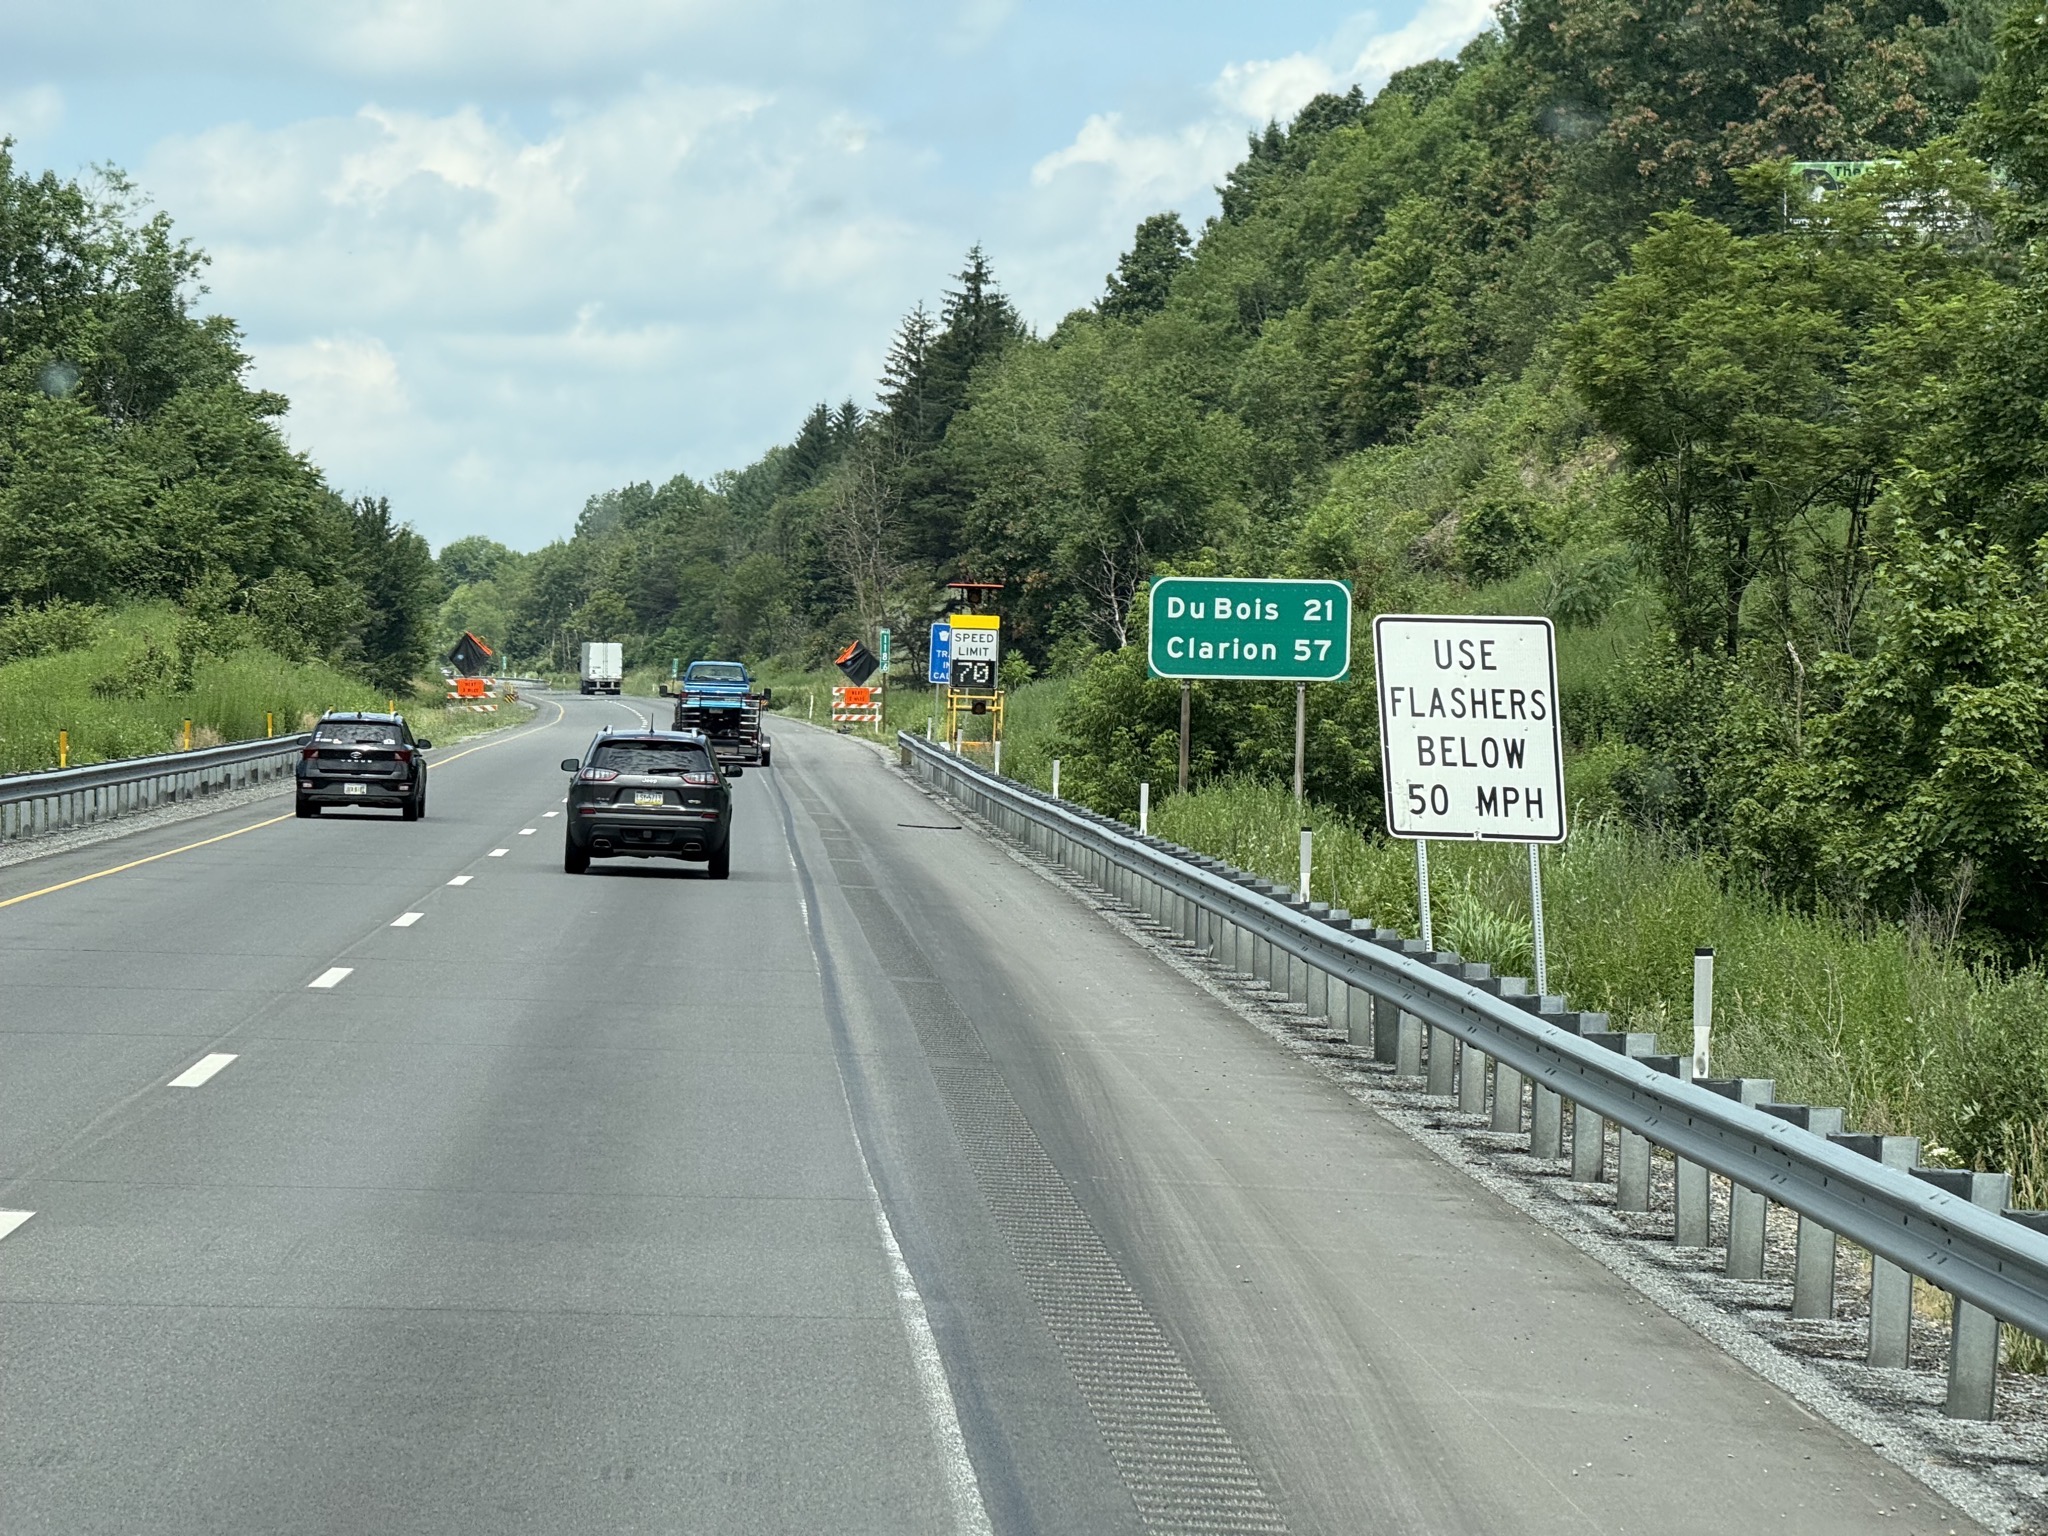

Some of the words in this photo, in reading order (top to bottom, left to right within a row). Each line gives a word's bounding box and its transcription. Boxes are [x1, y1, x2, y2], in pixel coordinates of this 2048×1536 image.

[1834, 166, 1861, 176] The
[1167, 597, 1205, 619] Du
[1214, 598, 1279, 620] Bois
[1303, 599, 1333, 621] 21
[954, 633, 994, 643] SPEED
[1167, 636, 1277, 660] Clarion
[1293, 639, 1332, 661] 57
[936, 650, 950, 658] TR
[958, 647, 989, 657] LIMIT
[1434, 639, 1497, 671] USE
[957, 662, 989, 683] 70
[1391, 687, 1546, 721] FLASHERS
[1417, 736, 1526, 769] BELOW
[1408, 784, 1449, 816] 50
[1477, 786, 1544, 819] MPH
